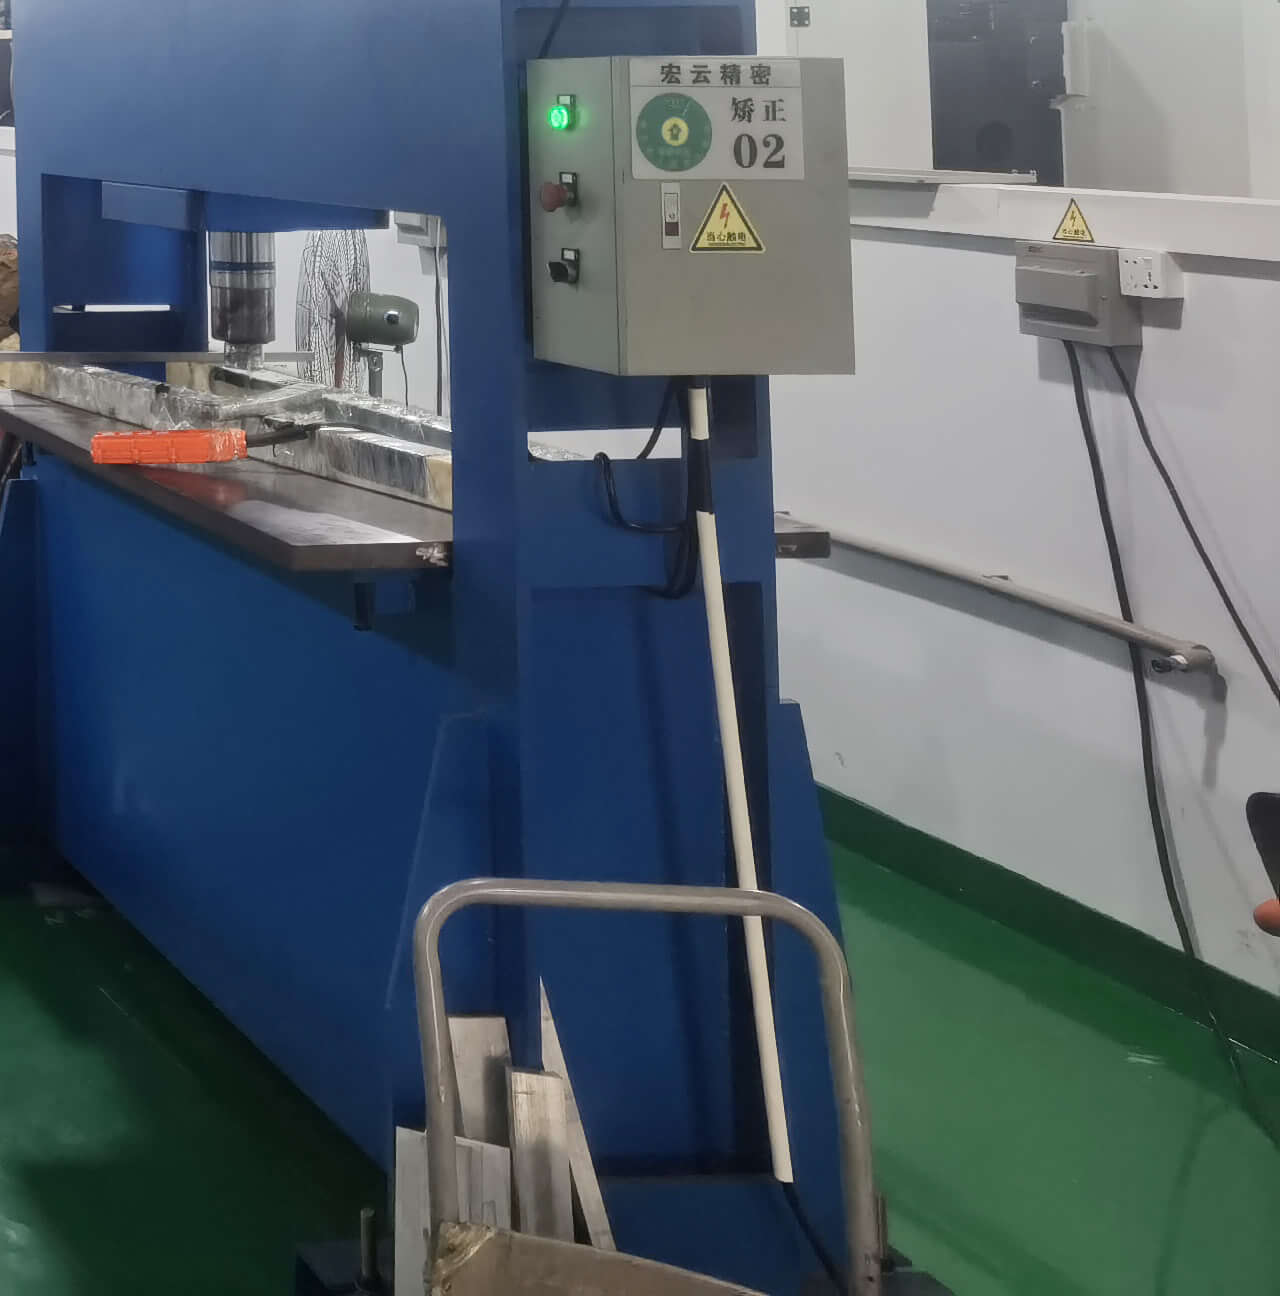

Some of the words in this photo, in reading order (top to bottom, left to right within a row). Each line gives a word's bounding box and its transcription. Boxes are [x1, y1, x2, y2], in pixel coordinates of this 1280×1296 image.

[660, 63, 772, 86] 宏云精密
[731, 96, 787, 123] 矫正
[733, 133, 786, 169] 02
